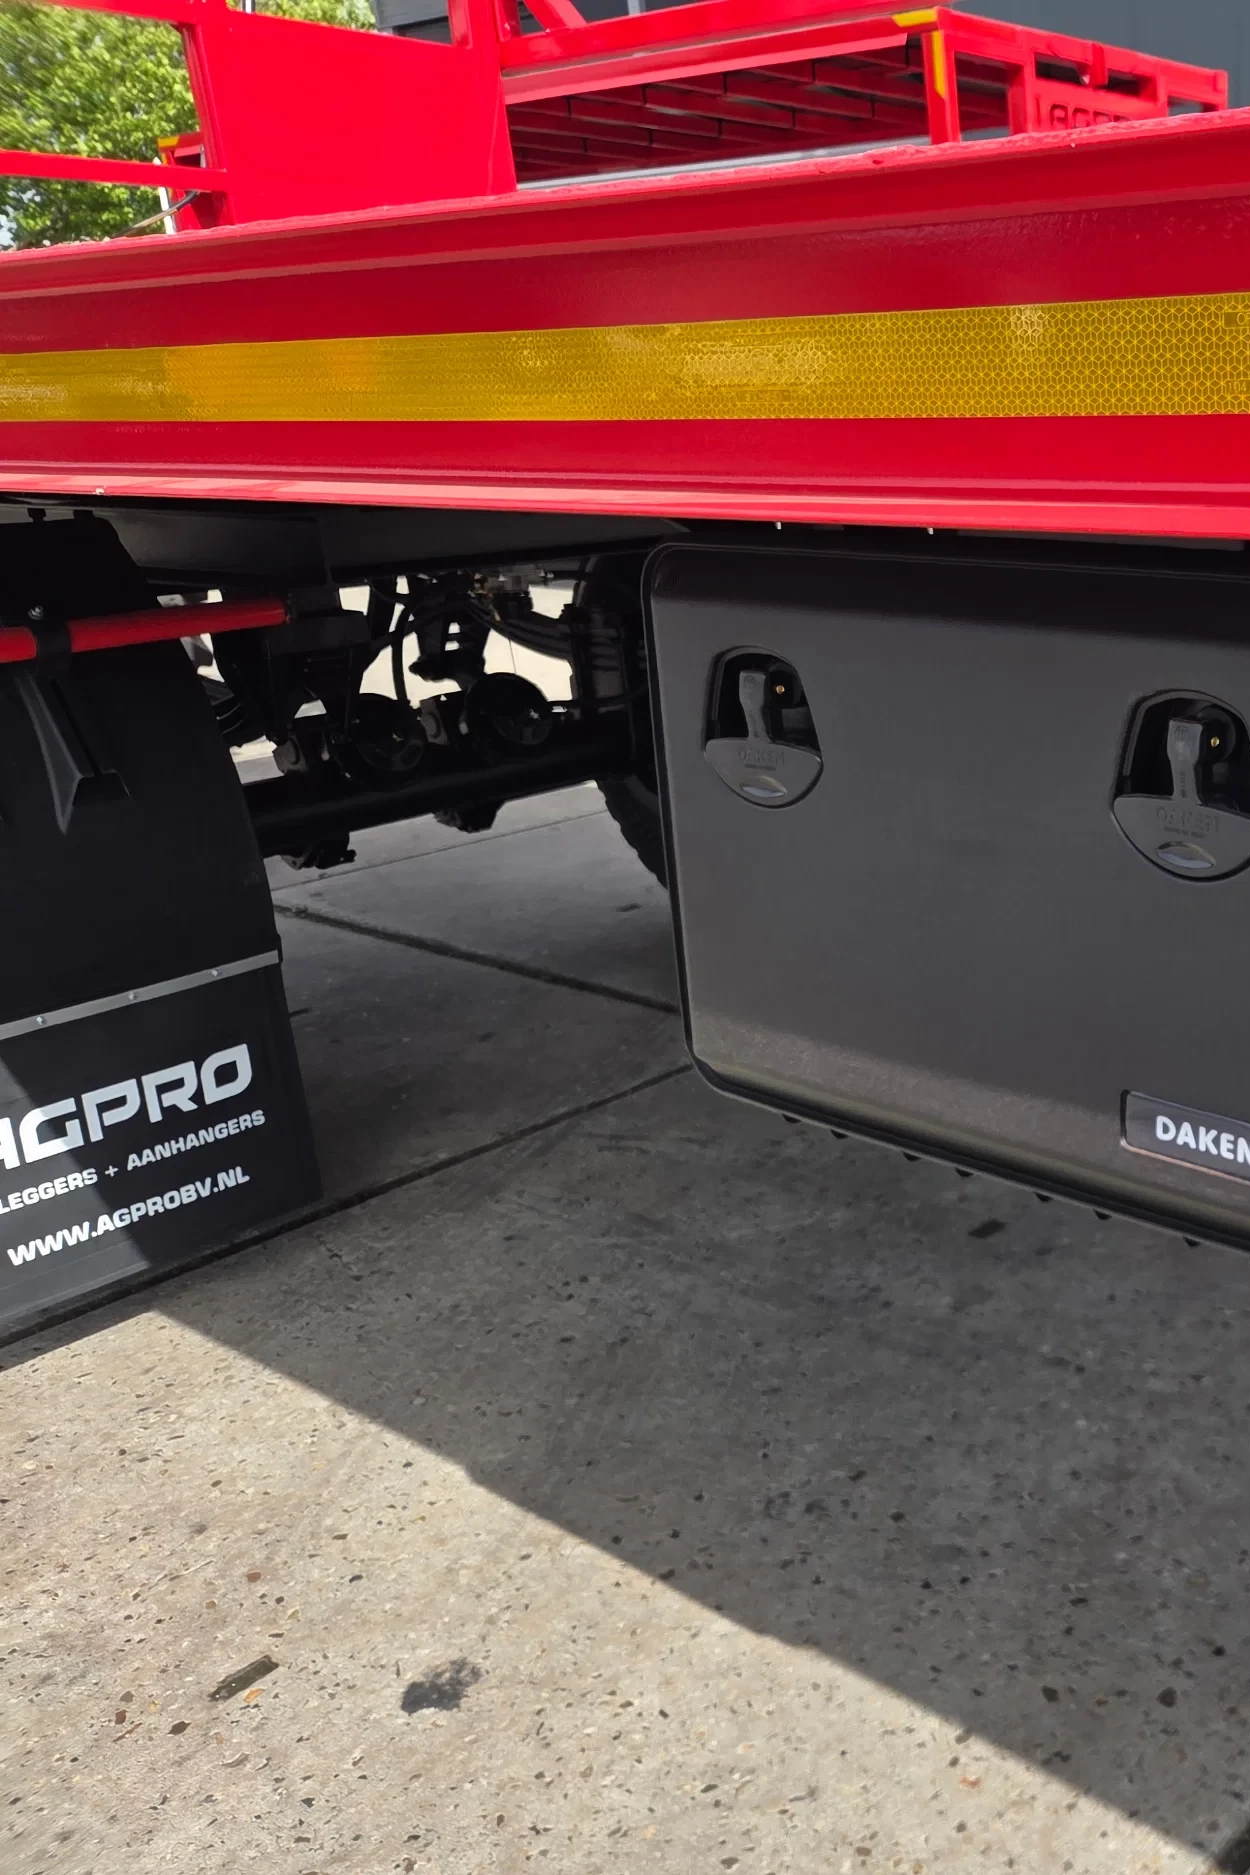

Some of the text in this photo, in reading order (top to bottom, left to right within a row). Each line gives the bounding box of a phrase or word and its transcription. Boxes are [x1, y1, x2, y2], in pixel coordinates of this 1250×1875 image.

[104, 1165, 119, 1178] +
[126, 1109, 266, 1171] AANHANGERS
[7, 1166, 251, 1267] WWW.AGPROBV.NL
